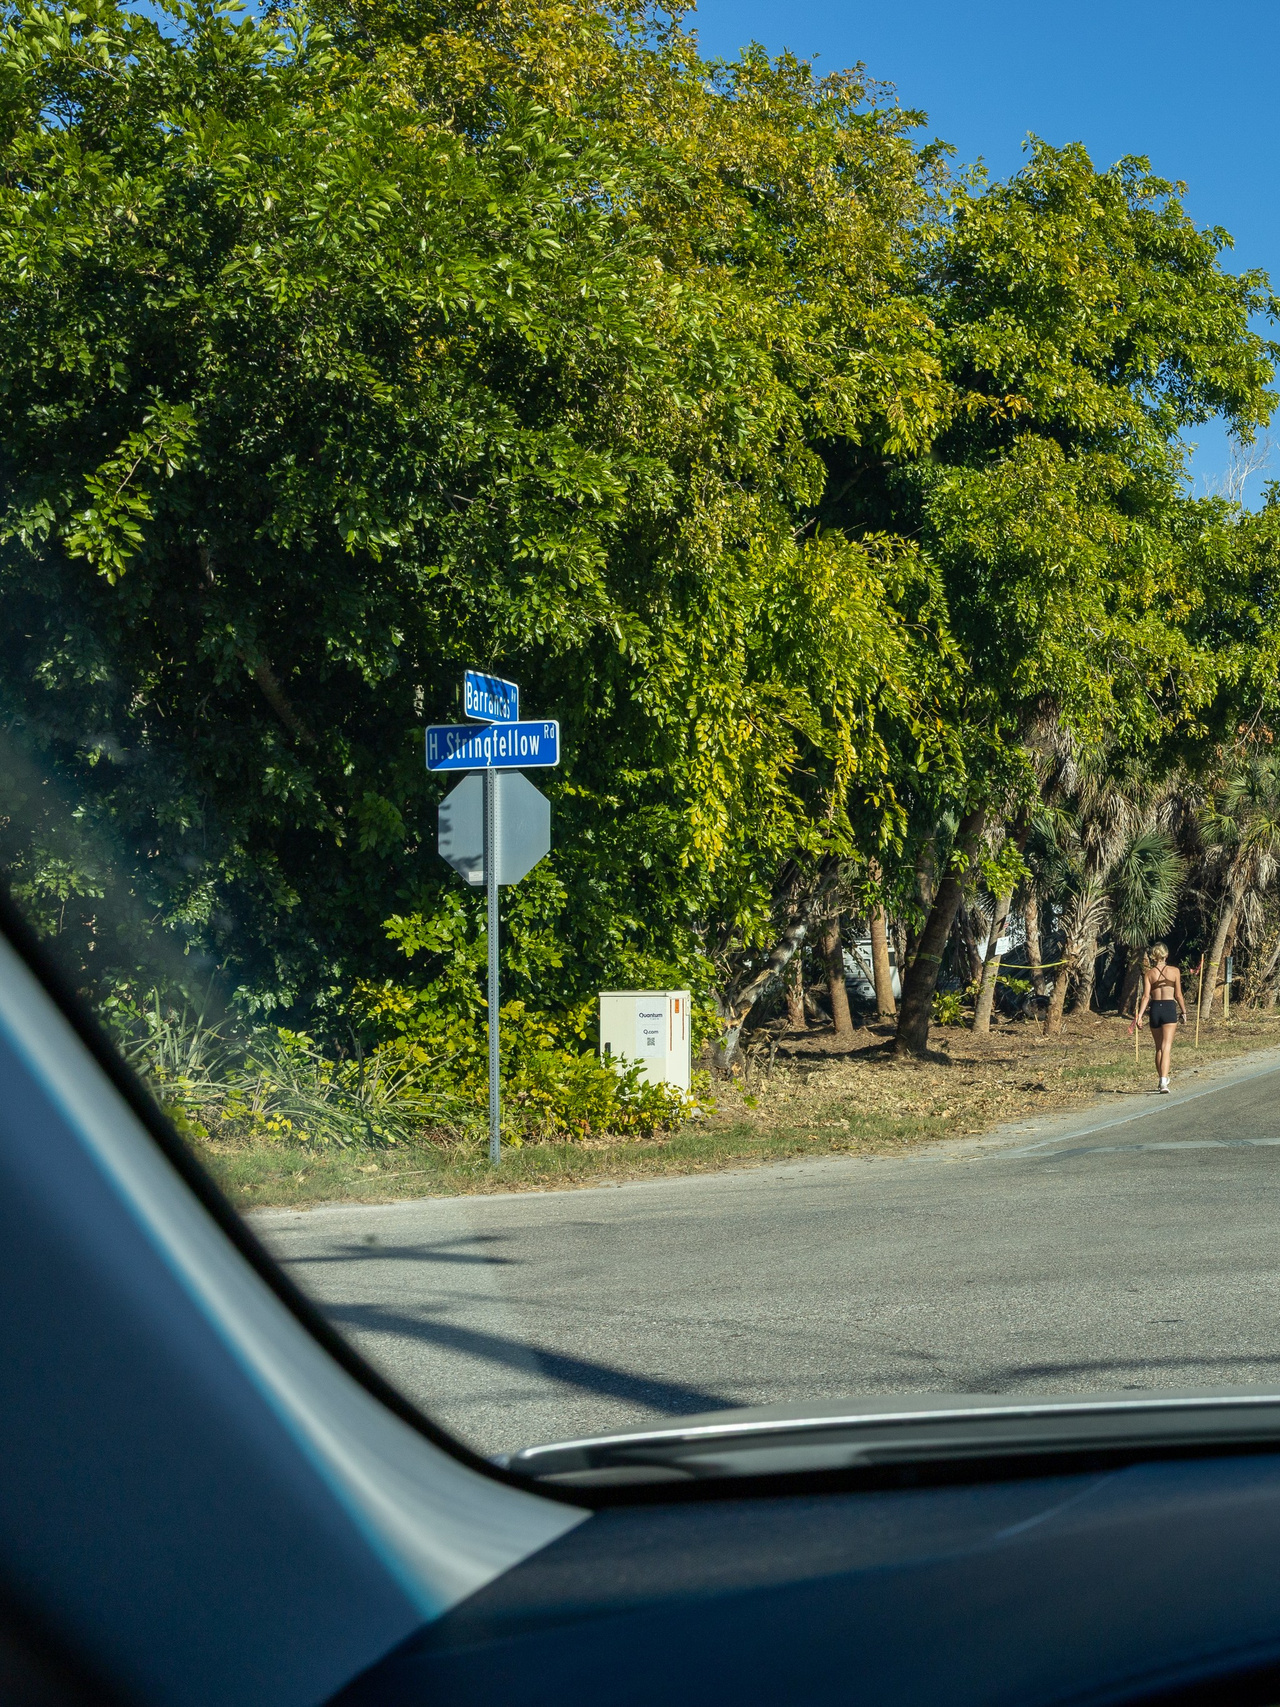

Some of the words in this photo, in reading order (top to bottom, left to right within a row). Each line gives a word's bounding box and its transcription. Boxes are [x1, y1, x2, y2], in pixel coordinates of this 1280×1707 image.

[429, 733, 444, 760] H.
[446, 728, 540, 766] Stringfellow
[543, 724, 555, 739] Rd
